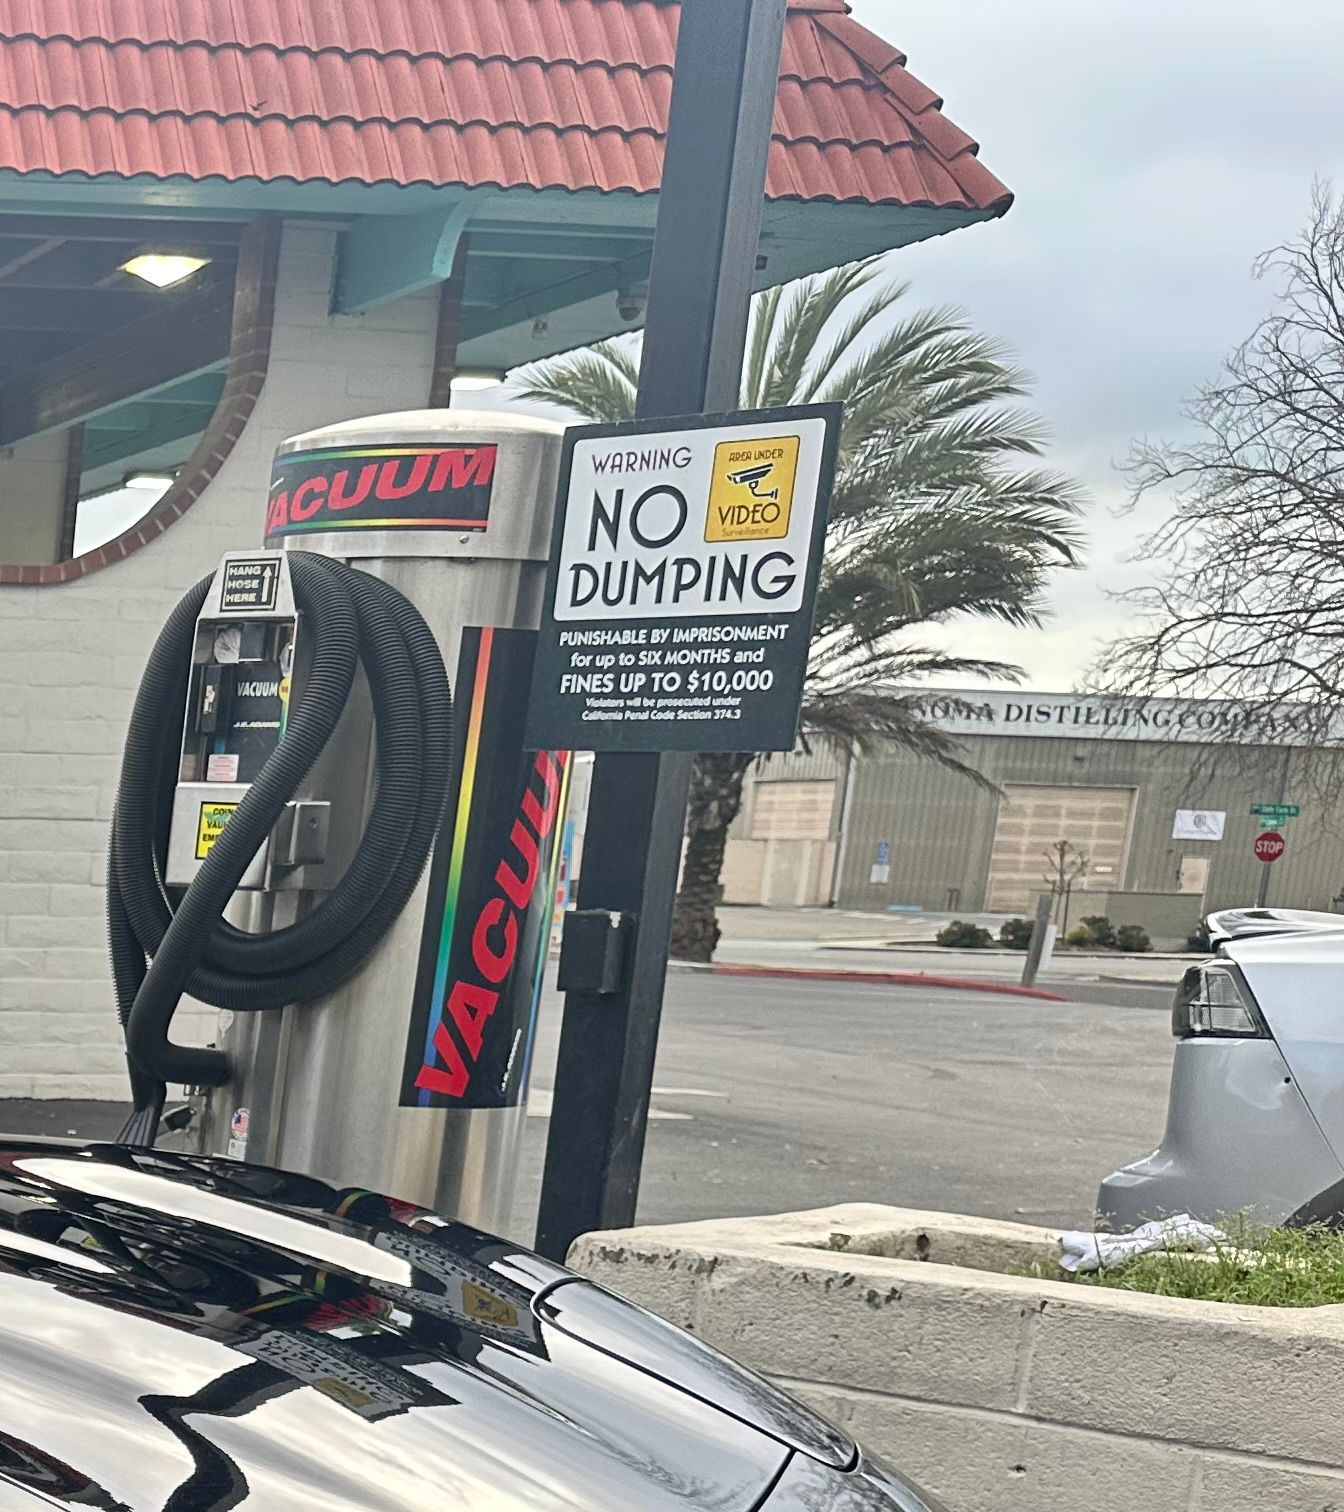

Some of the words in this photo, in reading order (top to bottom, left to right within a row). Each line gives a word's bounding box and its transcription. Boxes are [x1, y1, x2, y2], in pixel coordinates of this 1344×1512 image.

[592, 446, 692, 475] WARNING
[728, 450, 752, 462] AREA
[754, 448, 784, 460] UNDER
[587, 484, 688, 553] NO
[717, 502, 781, 526] VIDEO
[229, 565, 261, 576] HANG
[569, 551, 797, 608] DUMPING
[227, 579, 260, 590] HOSE
[225, 592, 257, 603] HERE
[559, 629, 647, 646] PUNISHABLE
[650, 629, 670, 645] BY
[672, 624, 789, 644] IMPRISONMENT
[570, 651, 593, 668] for
[595, 654, 616, 670] up
[618, 651, 635, 666] to
[637, 650, 662, 666] SIX
[663, 648, 731, 665] MONTHS
[733, 647, 766, 664] and
[237, 682, 279, 697] VACUUM
[559, 672, 614, 694] FINES
[619, 671, 647, 693] UP
[650, 670, 682, 693] TO
[686, 669, 774, 695] $10,000
[642, 696, 656, 707] be
[712, 695, 741, 706] under
[650, 709, 675, 721] Code
[676, 709, 712, 720] Section
[713, 708, 741, 720] 374.3
[1003, 703, 1171, 729] DISTILLING
[1255, 839, 1283, 854] STOP
[415, 750, 569, 1098] VACUU
